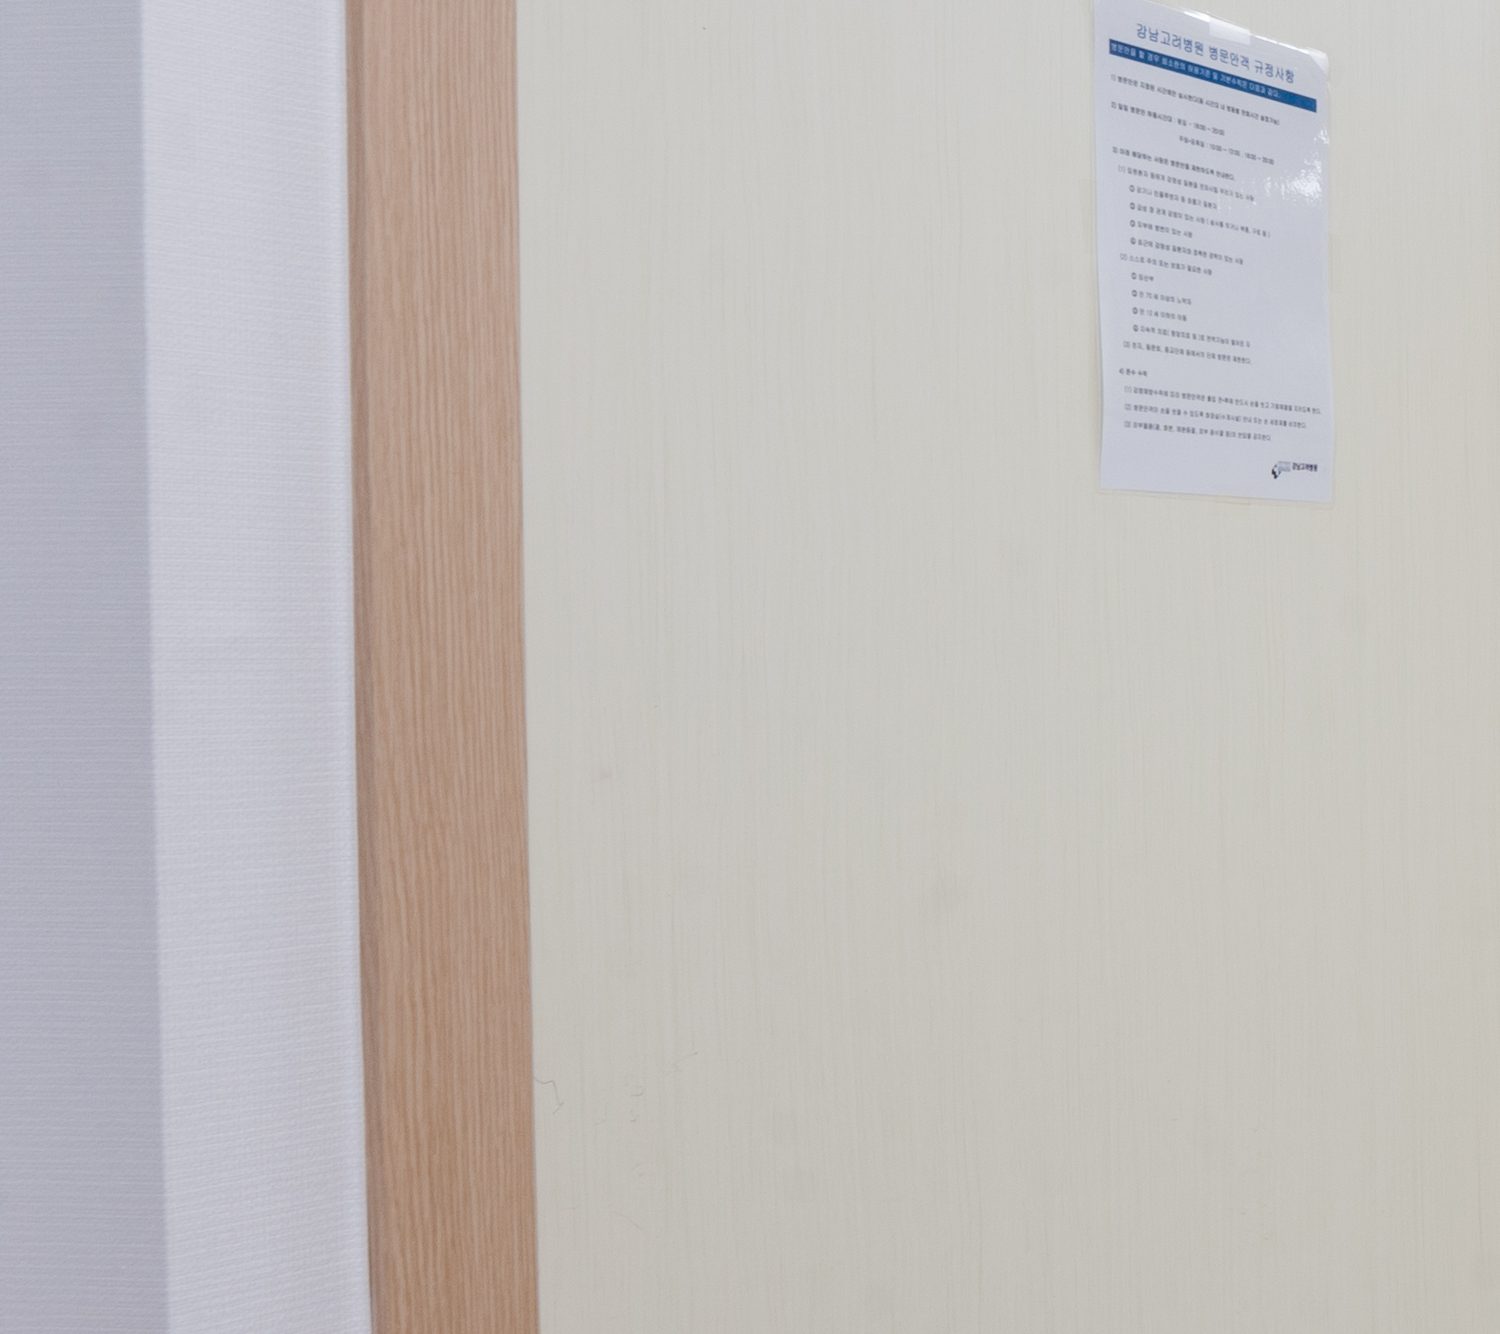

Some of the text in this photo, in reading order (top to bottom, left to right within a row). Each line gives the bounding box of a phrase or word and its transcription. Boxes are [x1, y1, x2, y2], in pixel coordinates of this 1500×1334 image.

[1136, 22, 1294, 84] 강남고려병원 병문안객 규정사항
